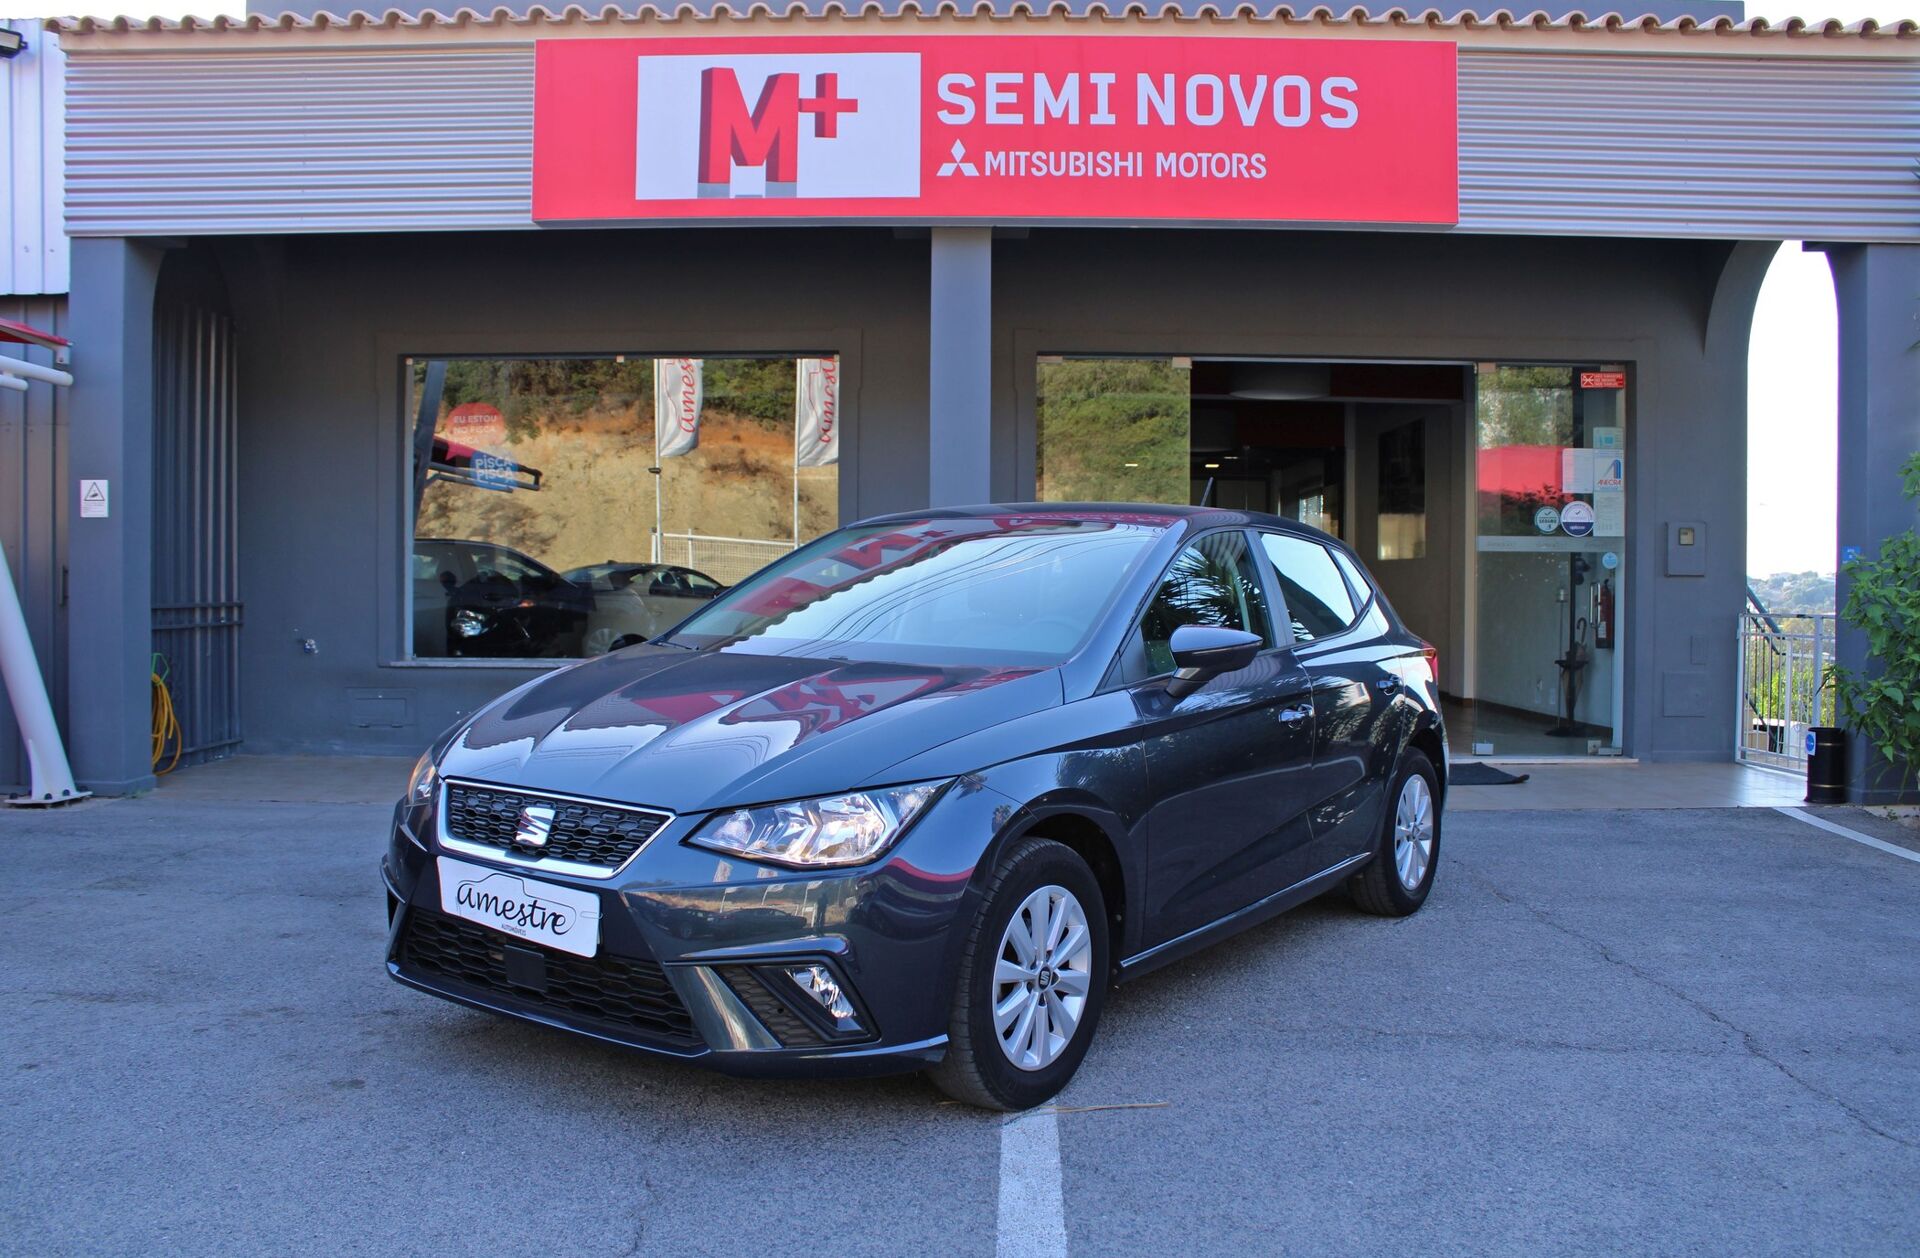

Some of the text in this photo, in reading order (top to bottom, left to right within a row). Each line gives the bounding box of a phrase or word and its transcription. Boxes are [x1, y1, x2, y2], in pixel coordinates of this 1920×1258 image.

[937, 73, 1359, 129] SEMI NOVOS
[985, 150, 1267, 179] MITSUBISHI MOTORS
[457, 883, 567, 936] amestre
